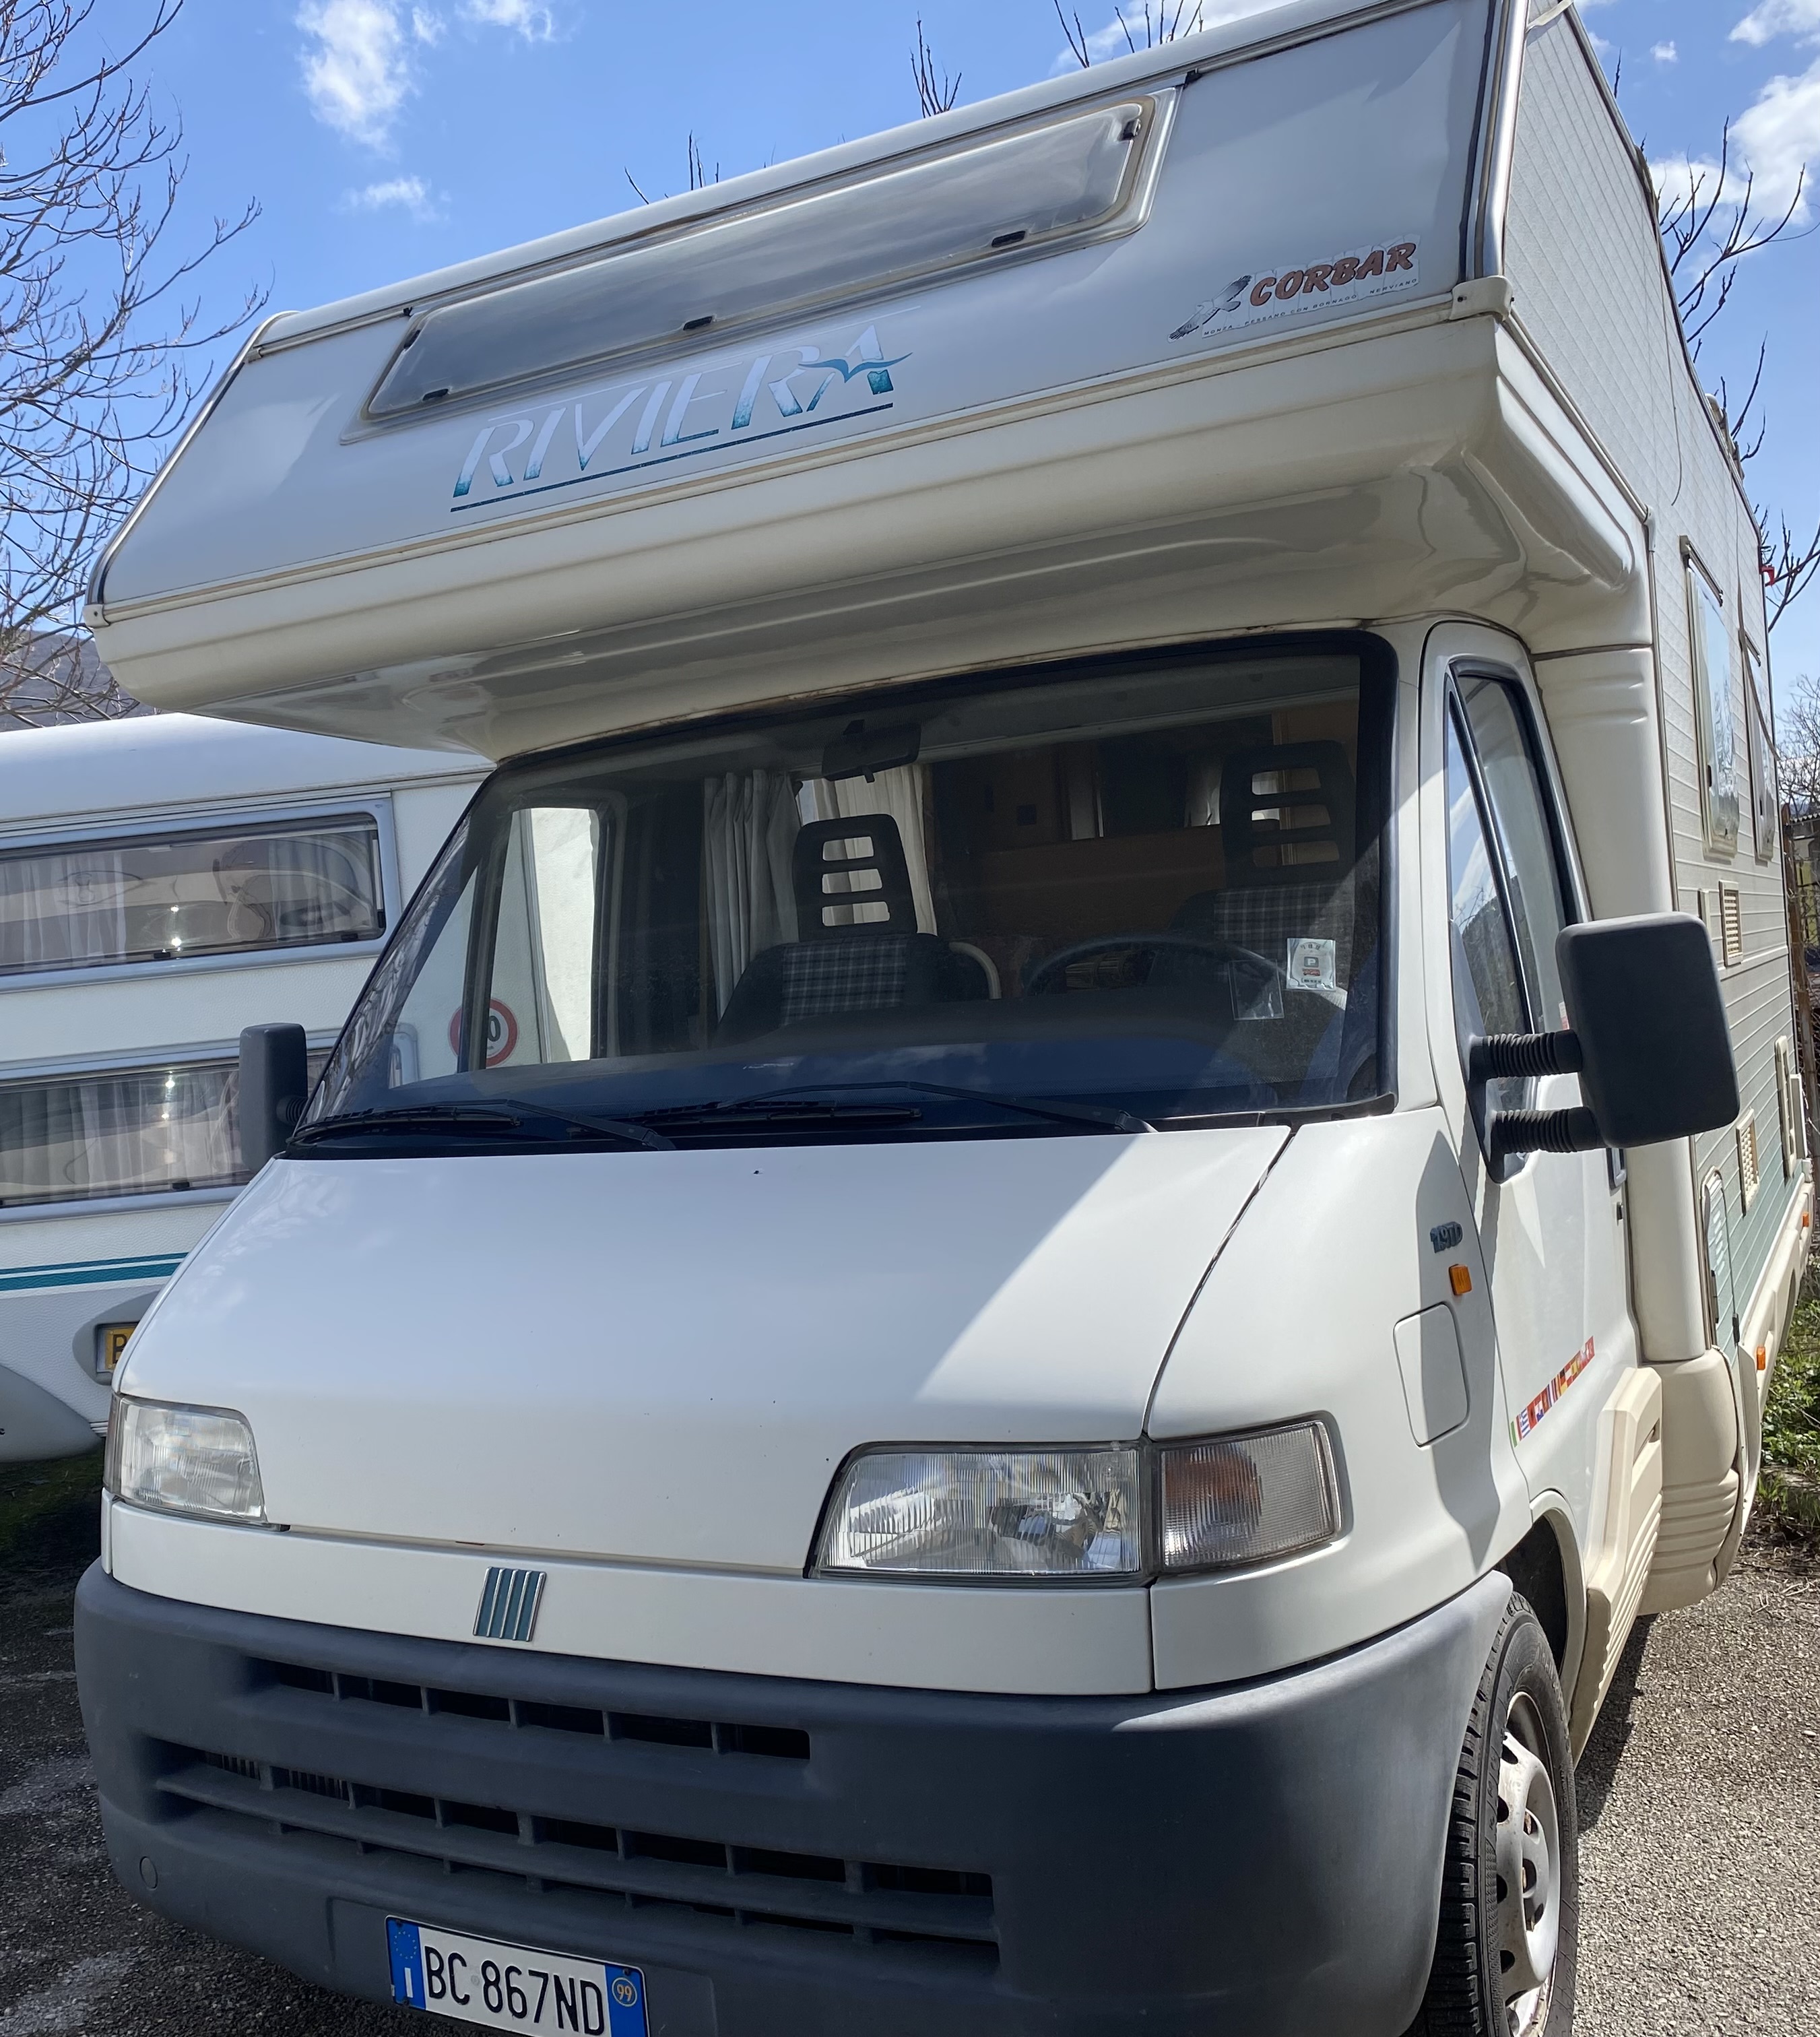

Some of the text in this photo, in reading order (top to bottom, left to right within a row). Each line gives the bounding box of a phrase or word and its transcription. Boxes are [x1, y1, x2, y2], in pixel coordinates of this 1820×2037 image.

[1204, 325, 1233, 335] MONZA
[1291, 306, 1309, 315] CON
[1370, 278, 1417, 294] NERVIANO
[1249, 242, 1417, 306] CORBAR
[453, 324, 903, 498] RIVIERA
[424, 1945, 470, 2005] BC
[481, 1960, 605, 2036] 867ND
[616, 1984, 632, 2001] 99
